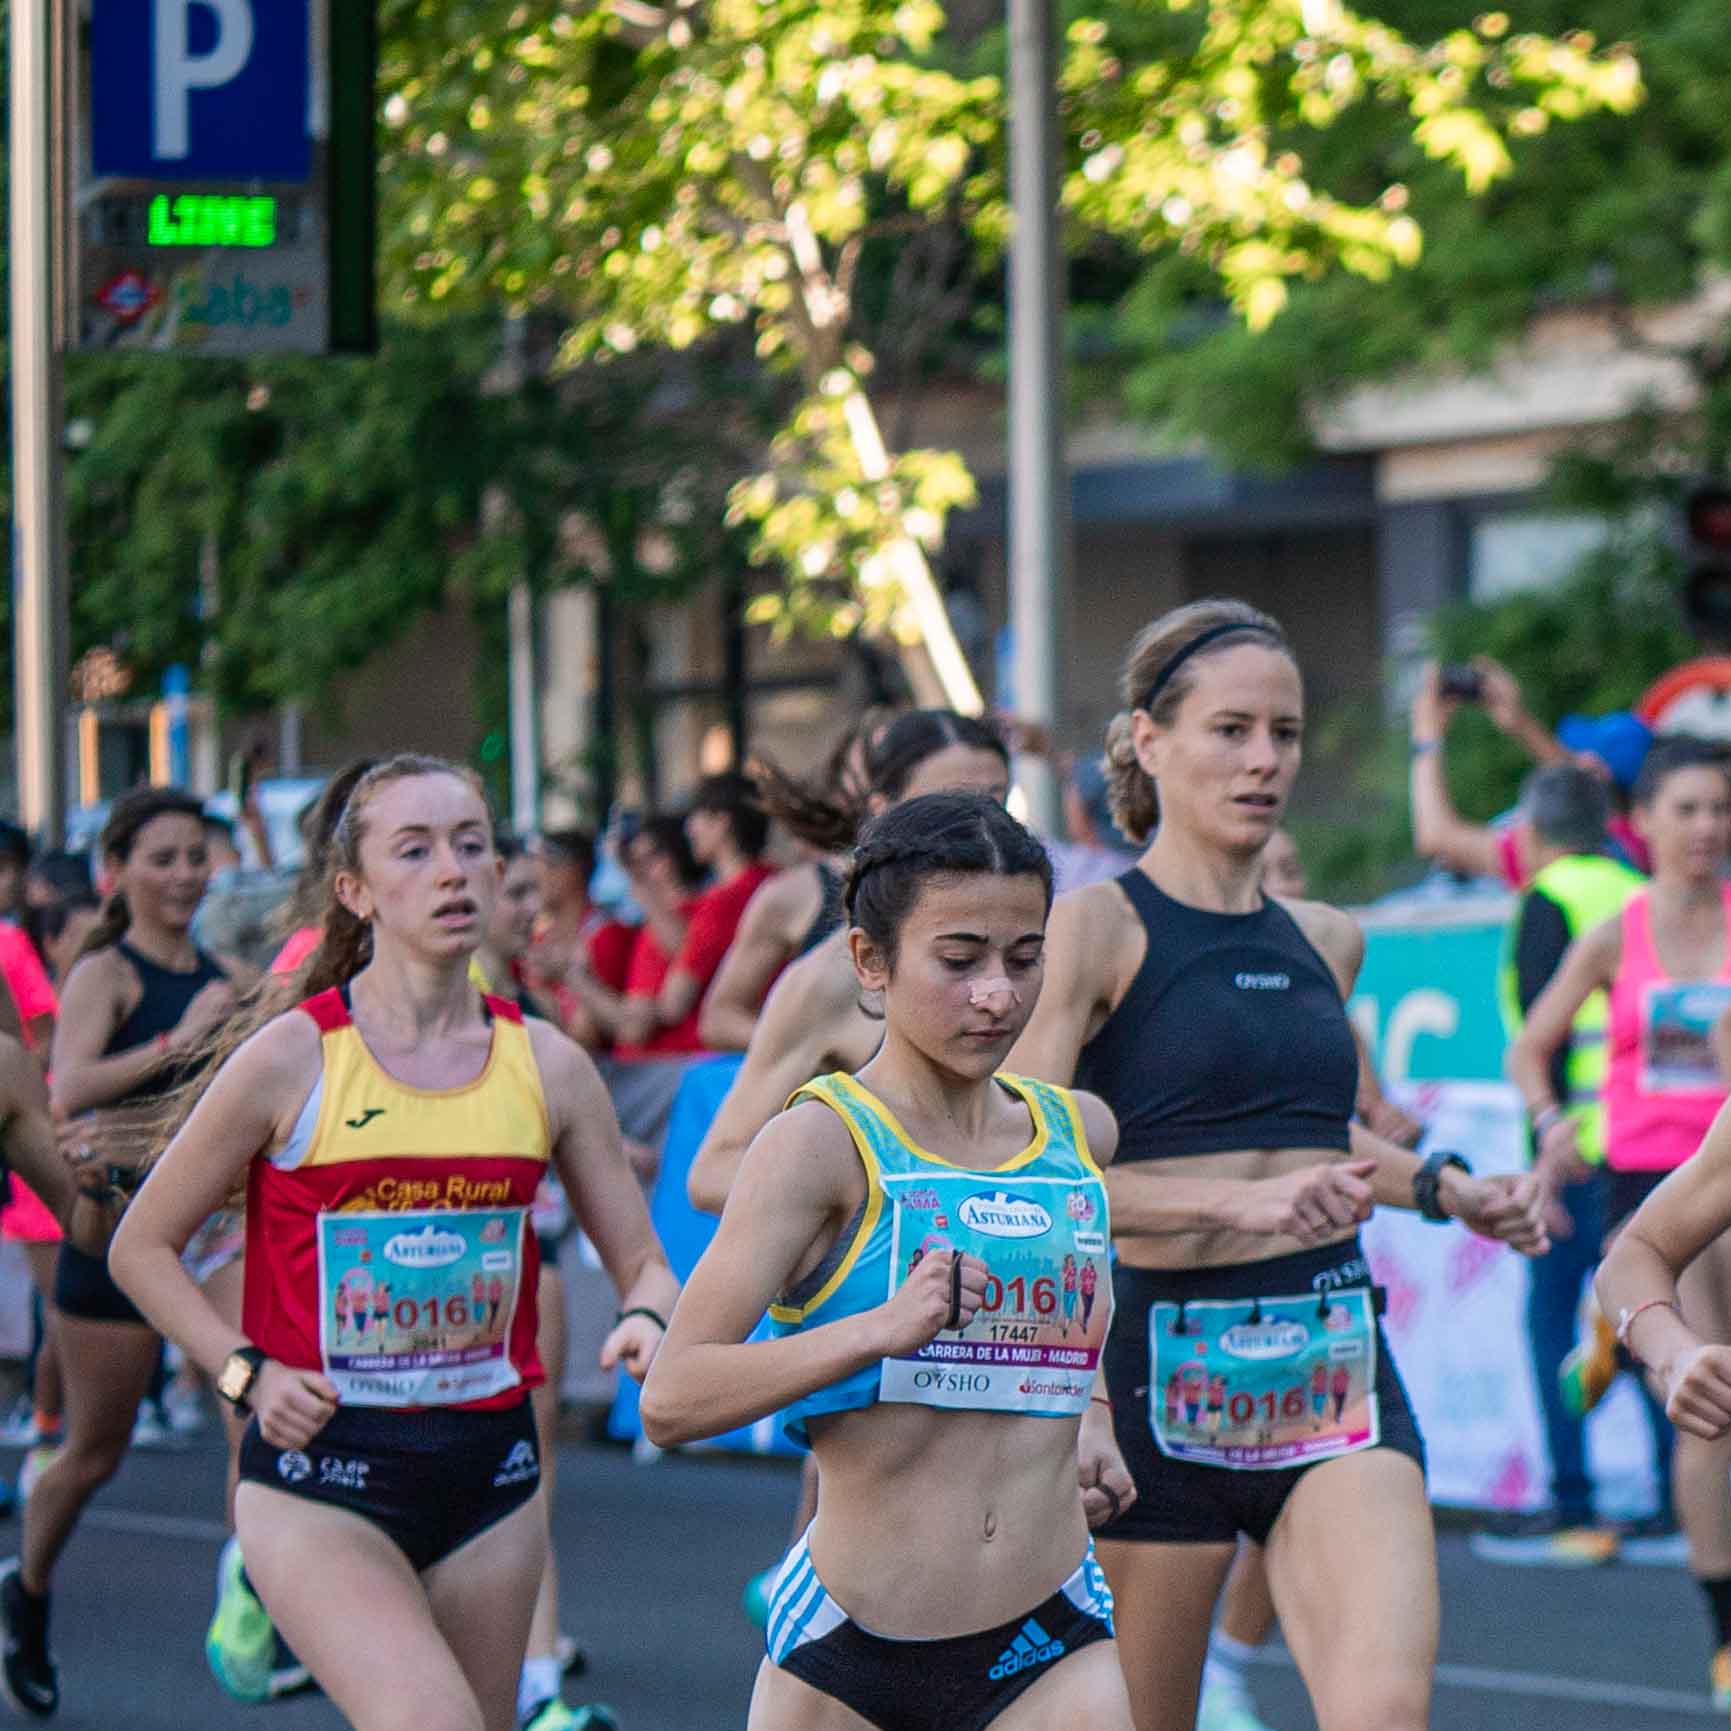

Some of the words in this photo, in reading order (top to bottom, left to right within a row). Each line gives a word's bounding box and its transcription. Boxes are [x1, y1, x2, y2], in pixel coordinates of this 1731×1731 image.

[154, 0, 254, 160] P
[377, 1177, 438, 1199] Casa
[447, 1175, 512, 1200] Rural
[967, 1204, 1047, 1228] ASTURIANA
[982, 1275, 1056, 1314] 016
[394, 1296, 468, 1329] 016
[990, 1325, 1038, 1343] 17447
[977, 1347, 993, 1360] DE
[995, 1348, 1009, 1361] LA
[914, 1371, 990, 1392] OYSHO
[1229, 1387, 1306, 1424] 016
[988, 1639, 1065, 1680] adidas
